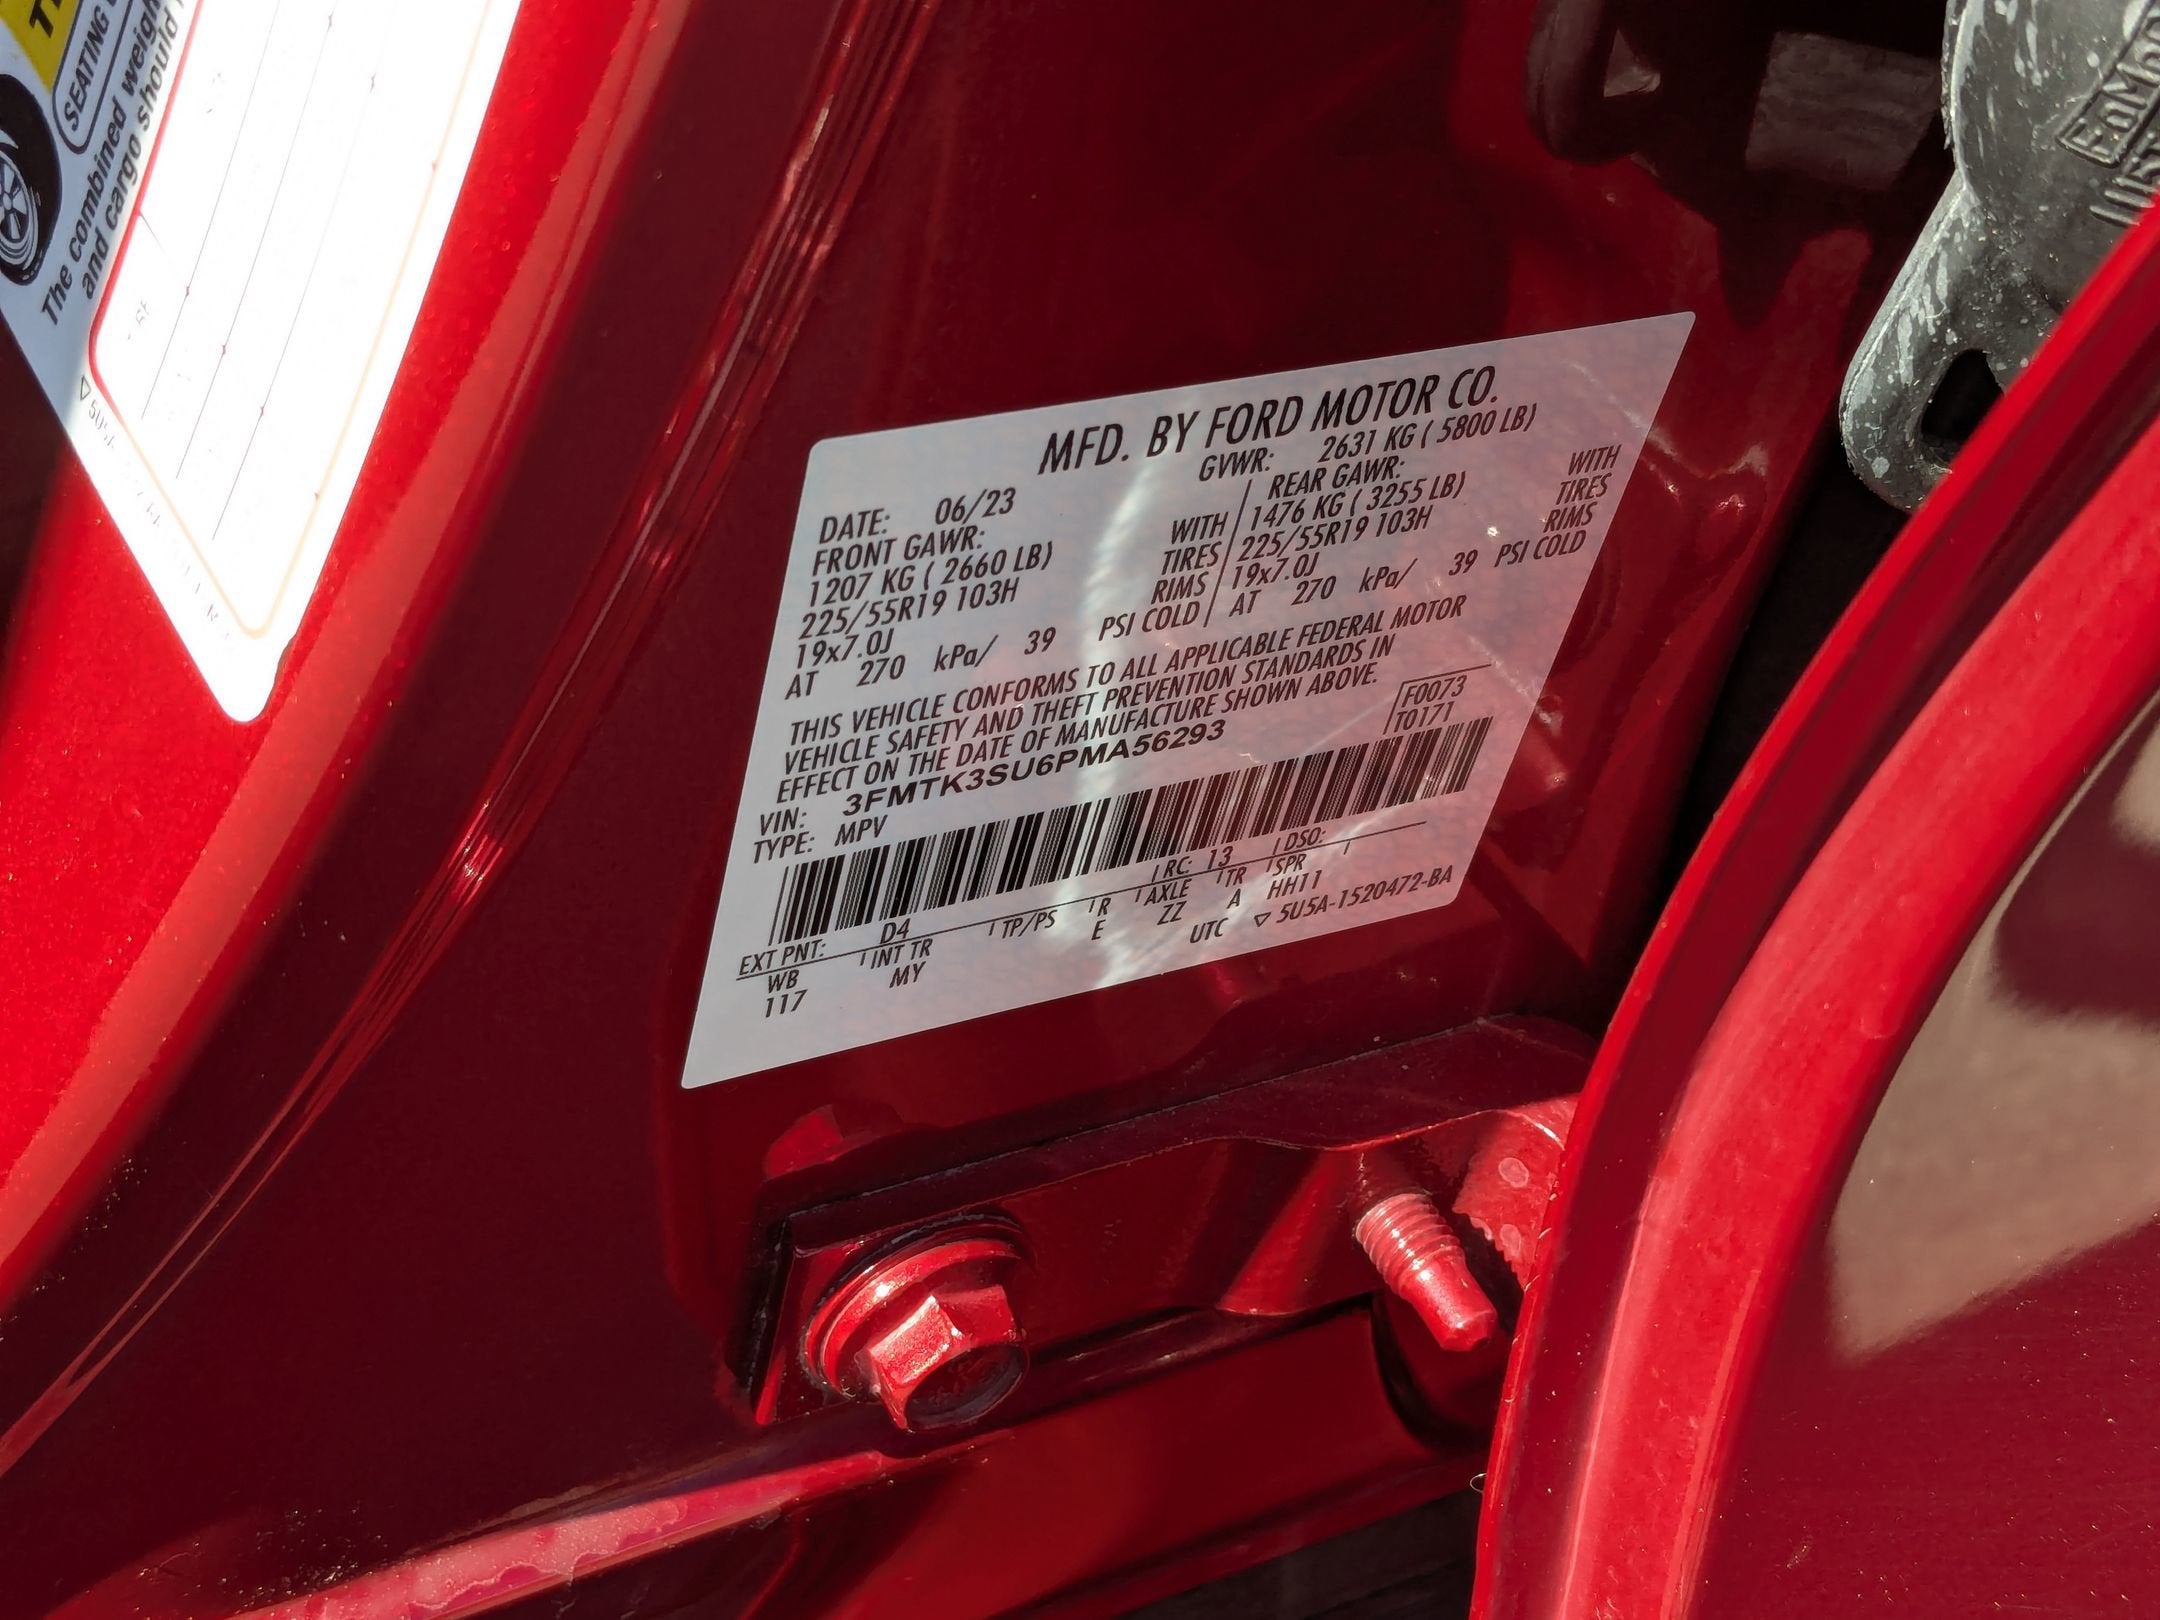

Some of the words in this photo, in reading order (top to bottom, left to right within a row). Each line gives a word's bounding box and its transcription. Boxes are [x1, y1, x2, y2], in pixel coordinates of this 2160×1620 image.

[64, 5, 110, 131] SEATING
[81, 230, 108, 300] and
[105, 133, 141, 231] cargo
[137, 6, 179, 132] should
[41, 264, 72, 325] The
[69, 96, 126, 262] combined
[1037, 423, 1129, 475] MFD.
[1146, 410, 1201, 458] BY
[1205, 396, 1304, 448] FORD
[1310, 374, 1441, 433] MOTOR
[1447, 365, 1498, 410] CO.
[1199, 447, 1275, 482] GVWR:
[1318, 429, 1377, 463] 2631
[1384, 422, 1418, 453] KG
[1436, 410, 1497, 444] 5800
[819, 508, 890, 545] DATE:
[935, 487, 1016, 525] 06/23
[1236, 515, 1370, 563] 225/55R19
[1376, 505, 1433, 538] 103H
[1555, 472, 1613, 505] TIRES
[1250, 500, 1305, 532] 1476
[1312, 491, 1343, 520] KG
[1370, 478, 1427, 511] 3255
[1567, 444, 1622, 476] WITH
[1268, 467, 1327, 500] REAR
[1331, 455, 1405, 490] GAWR:
[798, 589, 947, 640] 225/55R19
[957, 576, 1020, 612] 103H
[1161, 541, 1223, 576] TIRES
[809, 572, 874, 607] 1207
[880, 565, 915, 595] KG
[942, 549, 1006, 585] 2660
[1170, 511, 1228, 545] WITH
[813, 537, 897, 577] FRONT
[904, 524, 985, 561] GAWR:
[1229, 589, 1262, 618] AT
[1291, 576, 1337, 606] 270
[1448, 549, 1479, 577] 39
[1494, 540, 1530, 568] PSI
[1532, 530, 1587, 561] COLD
[1231, 552, 1320, 590] 19x7.0J
[1542, 501, 1598, 534] RIMS
[784, 671, 819, 699] AT
[857, 655, 905, 687] 270
[1024, 627, 1056, 655] 39
[1098, 612, 1136, 642] PSI
[1141, 601, 1201, 634] COLD
[797, 628, 895, 669] 19x7.0J
[1150, 571, 1210, 604] RIMS
[784, 734, 880, 776] VEHICLE
[887, 718, 967, 757] SAFETY
[972, 706, 1024, 739] AND
[1032, 691, 1100, 726] THEFT
[1102, 665, 1236, 715] PREVENTION
[1241, 634, 1366, 685] STANDARDS
[1369, 633, 1396, 660] IN
[790, 712, 843, 746] THIS
[852, 693, 947, 735] VEHICLE
[953, 667, 1080, 714] CONFORMS
[1087, 658, 1115, 686] TO
[1120, 654, 1159, 684] ALL
[1164, 627, 1293, 674] APPLICABLE
[1296, 610, 1385, 648] FEDERAL
[1390, 594, 1467, 630] MOTOR
[1393, 701, 1455, 733] T0171
[1403, 674, 1468, 708] F0073
[758, 806, 808, 837] VIN:
[842, 719, 1226, 817] 3FMTK3SU6PMA56293
[776, 766, 860, 804] EFFECT
[864, 759, 900, 786] ON
[909, 747, 950, 778] THE
[955, 734, 1012, 767] DATE
[1020, 727, 1052, 753] OF
[1054, 692, 1218, 747] MANUFACTURE
[1220, 678, 1302, 714] SHOWN
[1305, 662, 1379, 698] ABOVE.
[753, 831, 815, 864] TYPE:
[834, 814, 889, 848] MPV
[738, 949, 778, 976] EXT
[781, 939, 827, 967] PNT:
[880, 918, 910, 945] D4
[1163, 855, 1193, 879] RC:
[1207, 845, 1234, 870] 13
[1284, 827, 1327, 855] DSO:
[765, 988, 808, 1018] 117
[889, 961, 926, 989] MY
[1091, 919, 1105, 941] E
[1157, 901, 1187, 926] ZZ
[1226, 888, 1241, 909] A
[1267, 869, 1324, 900] HH11
[768, 969, 800, 994] WB
[871, 943, 905, 970] INT
[910, 938, 934, 957] TR
[1001, 909, 1057, 940] TP/PS
[1097, 897, 1112, 917] R
[1144, 878, 1193, 906] AXLE
[1225, 866, 1247, 886] TR
[1272, 852, 1308, 877] SPR
[1189, 917, 1229, 945] UTC
[1276, 864, 1453, 924] 5U5A-1520472-BA
